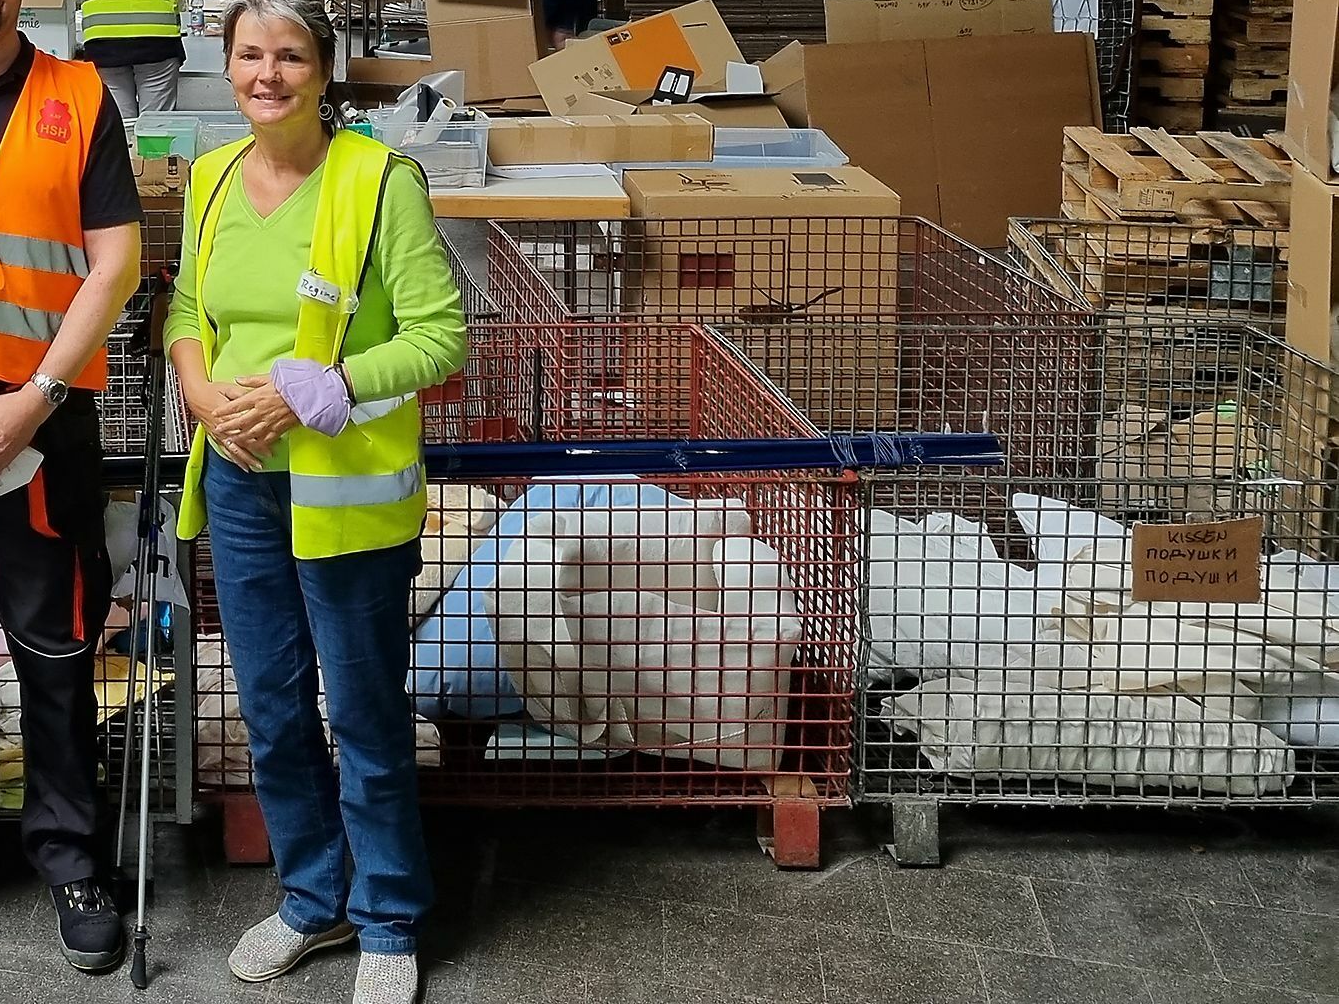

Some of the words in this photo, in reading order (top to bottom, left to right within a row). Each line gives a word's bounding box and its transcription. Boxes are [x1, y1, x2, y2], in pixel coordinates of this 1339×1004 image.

[18, 17, 40, 29] onie
[40, 123, 67, 138] HSH
[1167, 529, 1228, 543] KISSEN
[1146, 547, 1238, 561] ПОДУШКИ
[1145, 570, 1239, 585] ПОДУШИ
